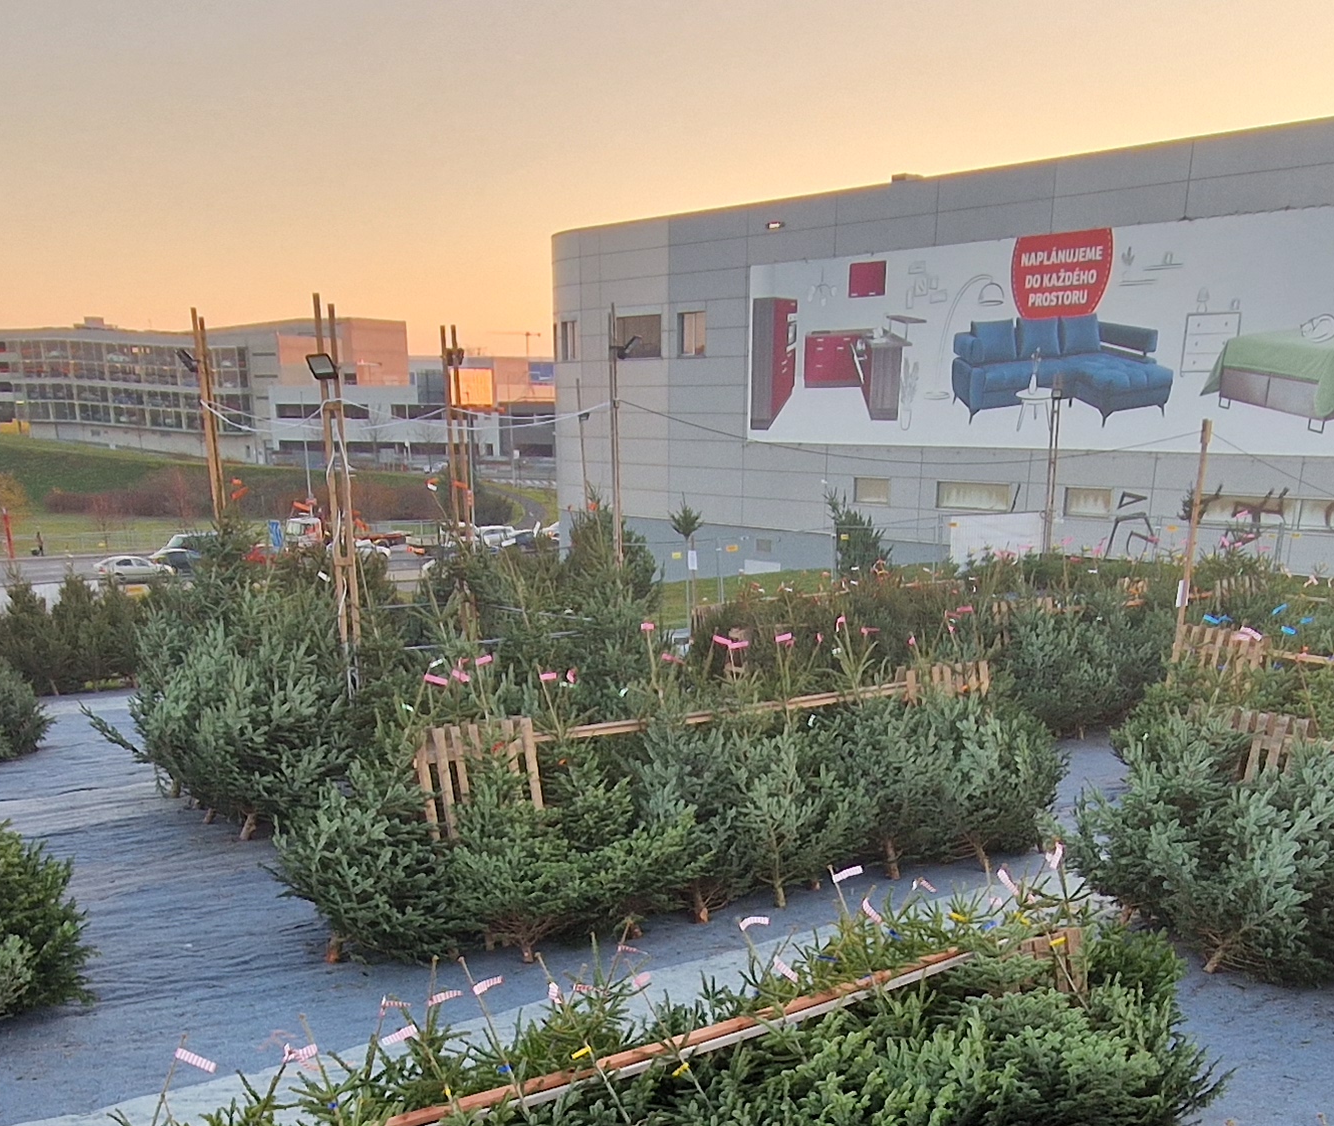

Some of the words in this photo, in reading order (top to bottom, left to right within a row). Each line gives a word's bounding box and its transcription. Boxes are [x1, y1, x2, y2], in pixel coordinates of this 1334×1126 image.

[1021, 246, 1104, 267] NAPLÁNUJEME
[1025, 274, 1041, 289] DO
[1043, 267, 1097, 288] KAŽDÉHO
[1028, 289, 1088, 307] PROSTORU
